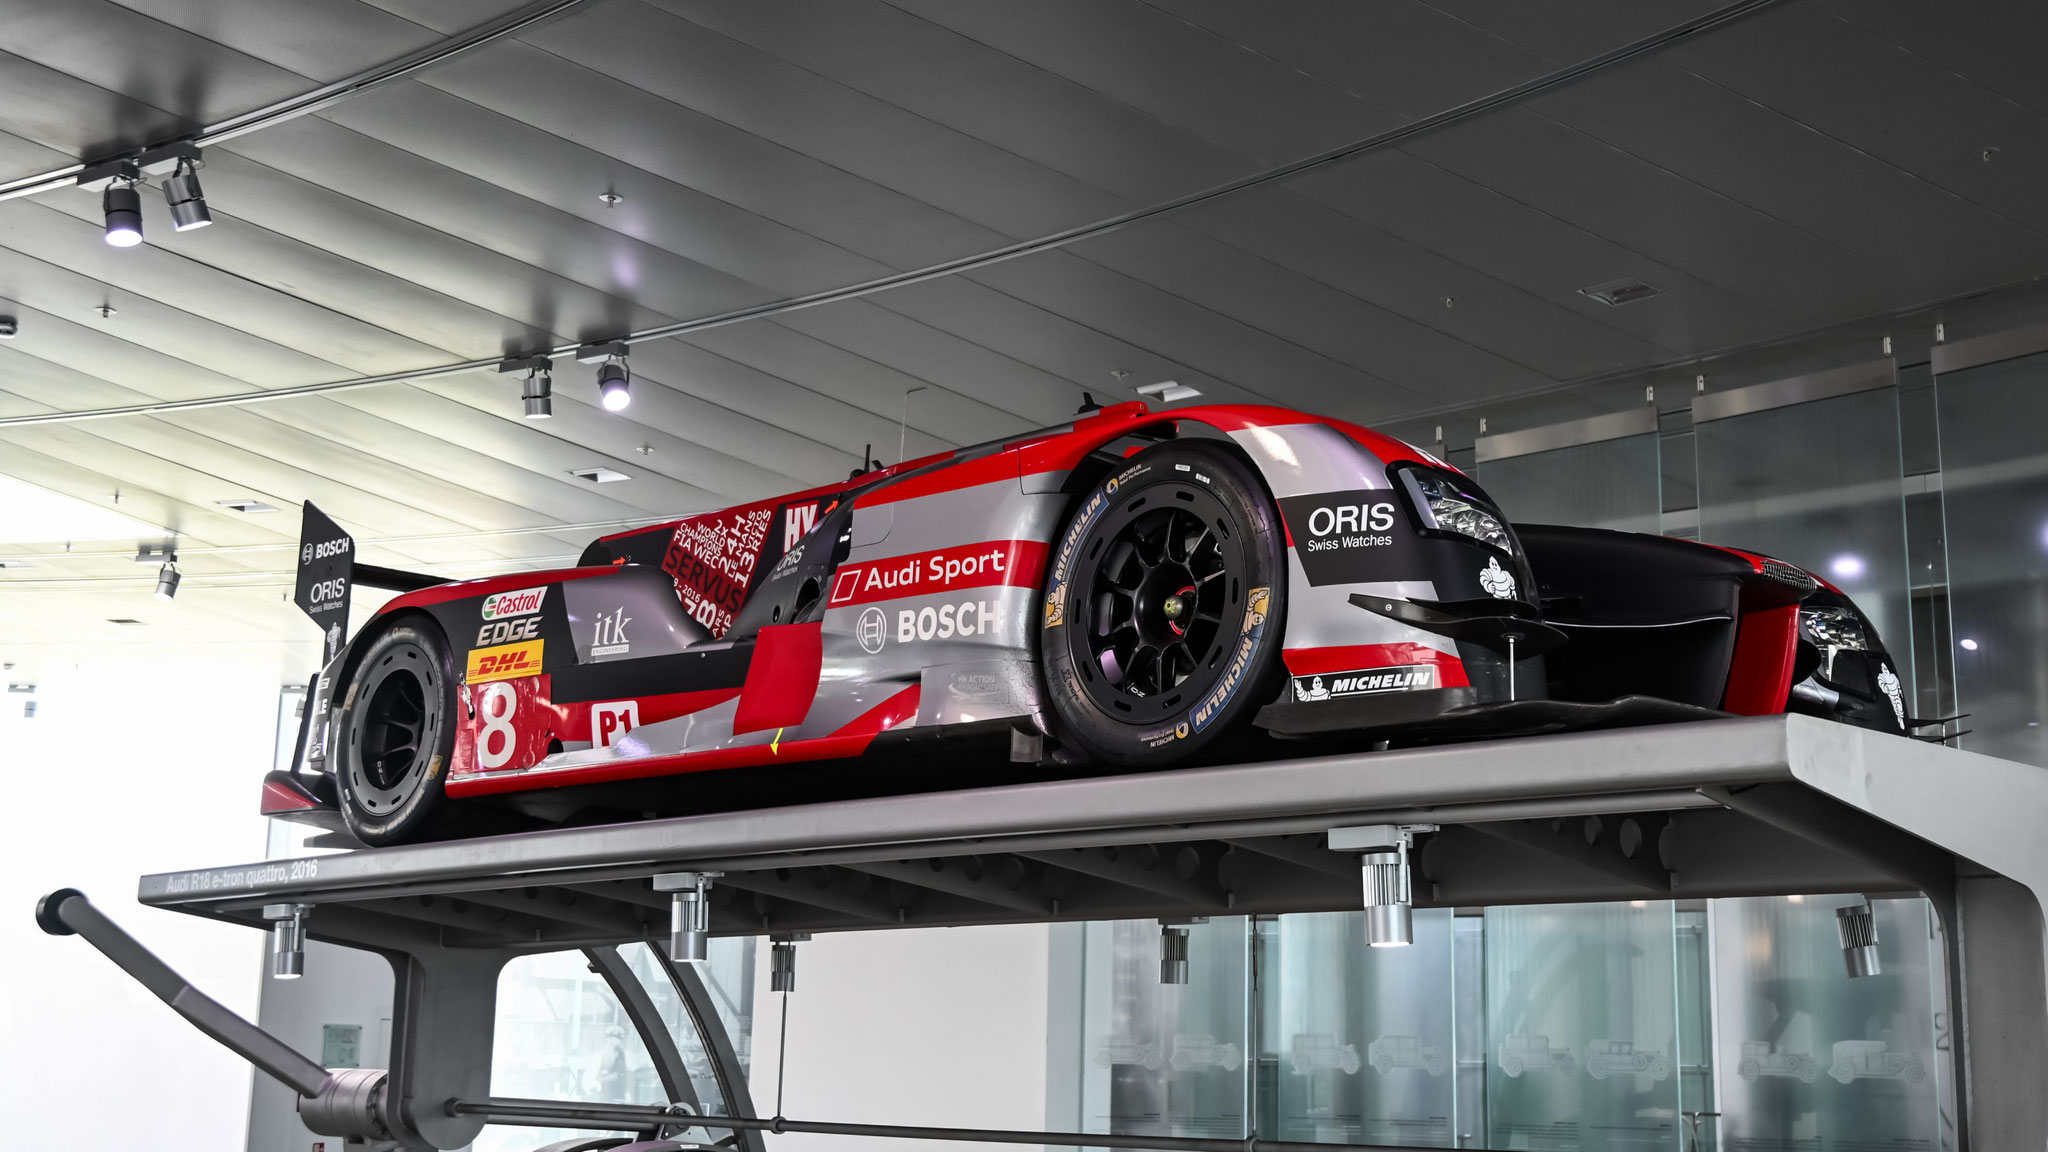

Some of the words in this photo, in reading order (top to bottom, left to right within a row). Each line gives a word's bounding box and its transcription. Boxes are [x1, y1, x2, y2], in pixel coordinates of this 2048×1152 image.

[1119, 464, 1142, 480] MICHELIN
[697, 521, 726, 548] WORLD
[745, 511, 764, 549] VICTO
[751, 509, 771, 552] RIES
[1308, 503, 1394, 536] ORIS
[315, 537, 349, 559] BOSCH
[673, 529, 691, 552] FIA
[694, 542, 720, 569] WEC
[680, 522, 722, 557] CHAMPIONS
[718, 515, 746, 574] 24H
[727, 559, 739, 578] LE
[735, 510, 756, 557] MANS
[1054, 493, 1101, 581] MICHELIN
[1307, 538, 1338, 552] Swiss
[1341, 533, 1392, 549] Watches
[734, 551, 755, 588] 13
[776, 545, 805, 572] ORIS
[864, 560, 920, 591] Audi
[929, 549, 1005, 584] Sport
[311, 577, 345, 603] ORIS
[666, 545, 743, 614] SERVUS
[682, 584, 701, 603] 2016
[309, 605, 323, 614] Swiss
[323, 600, 343, 611] Watches
[496, 591, 541, 616] Castrol
[476, 616, 544, 647] EDGE
[592, 606, 632, 646] itk
[898, 600, 1002, 643] BOSCH
[477, 650, 530, 675] DHL
[592, 644, 629, 656] ENGINEERING
[968, 675, 995, 683] ACTION
[1195, 636, 1253, 726] MICHELIN
[1331, 672, 1430, 693] MICHELIN
[478, 682, 517, 768] 8
[600, 709, 632, 747] P1
[1149, 734, 1174, 748] MICHELIN
[166, 875, 190, 893] Audi
[191, 872, 210, 890] R18
[212, 870, 244, 888] e-tron
[246, 865, 288, 888] quattro,
[291, 858, 318, 879] 2016
